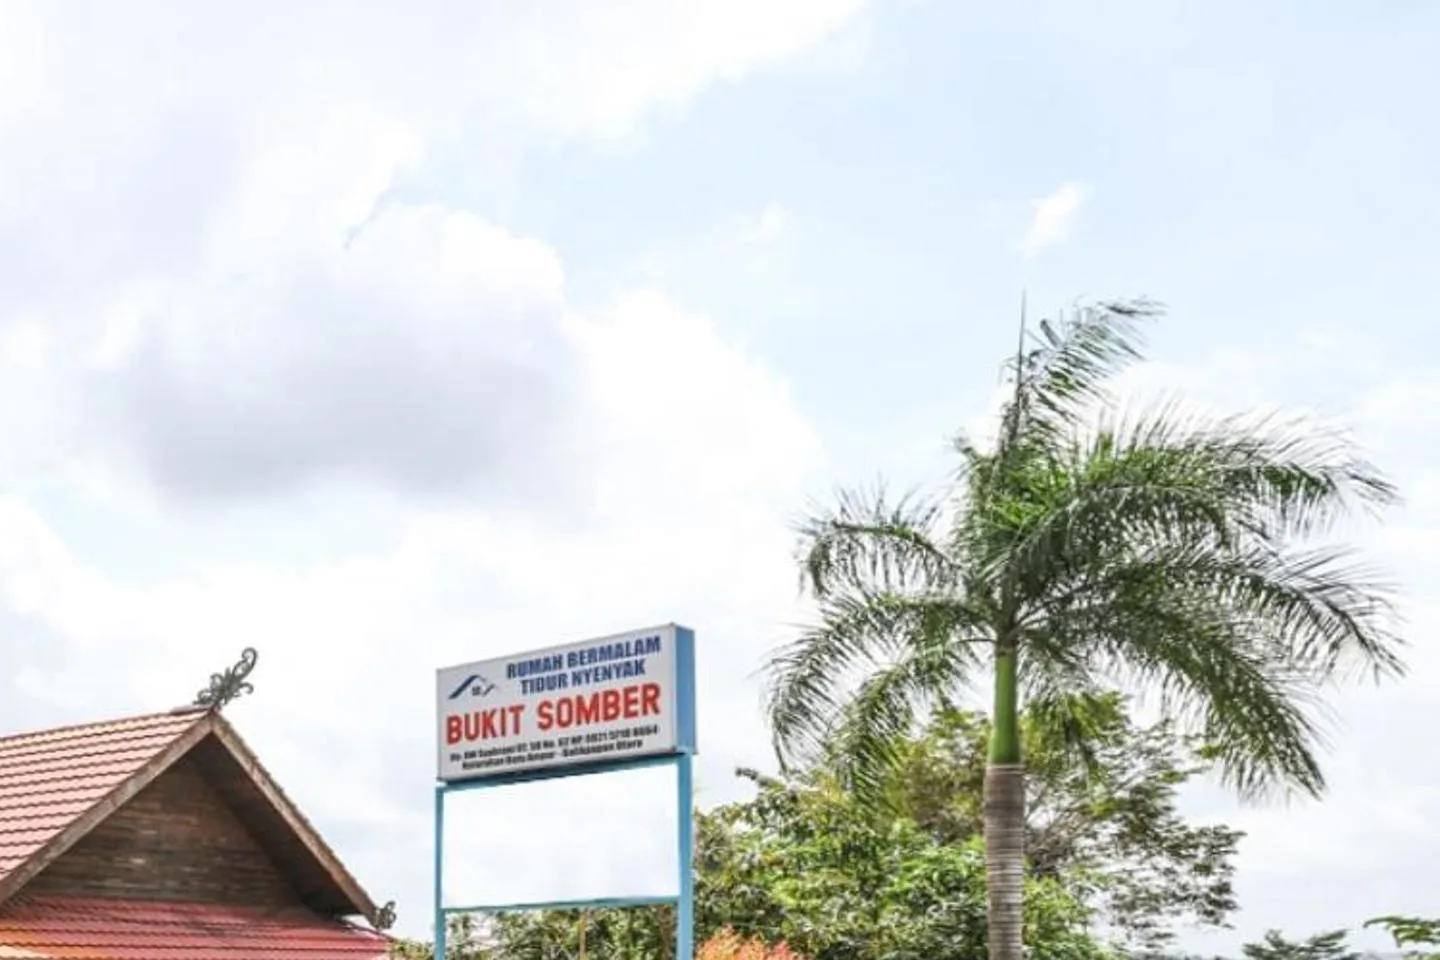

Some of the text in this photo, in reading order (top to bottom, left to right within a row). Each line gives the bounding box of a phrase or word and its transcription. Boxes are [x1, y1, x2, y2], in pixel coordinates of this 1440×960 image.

[507, 635, 661, 679] RUMAH BERMALAM
[521, 659, 646, 696] TIDUR NYENYAK
[446, 682, 661, 745] BUKIT SOMBER
